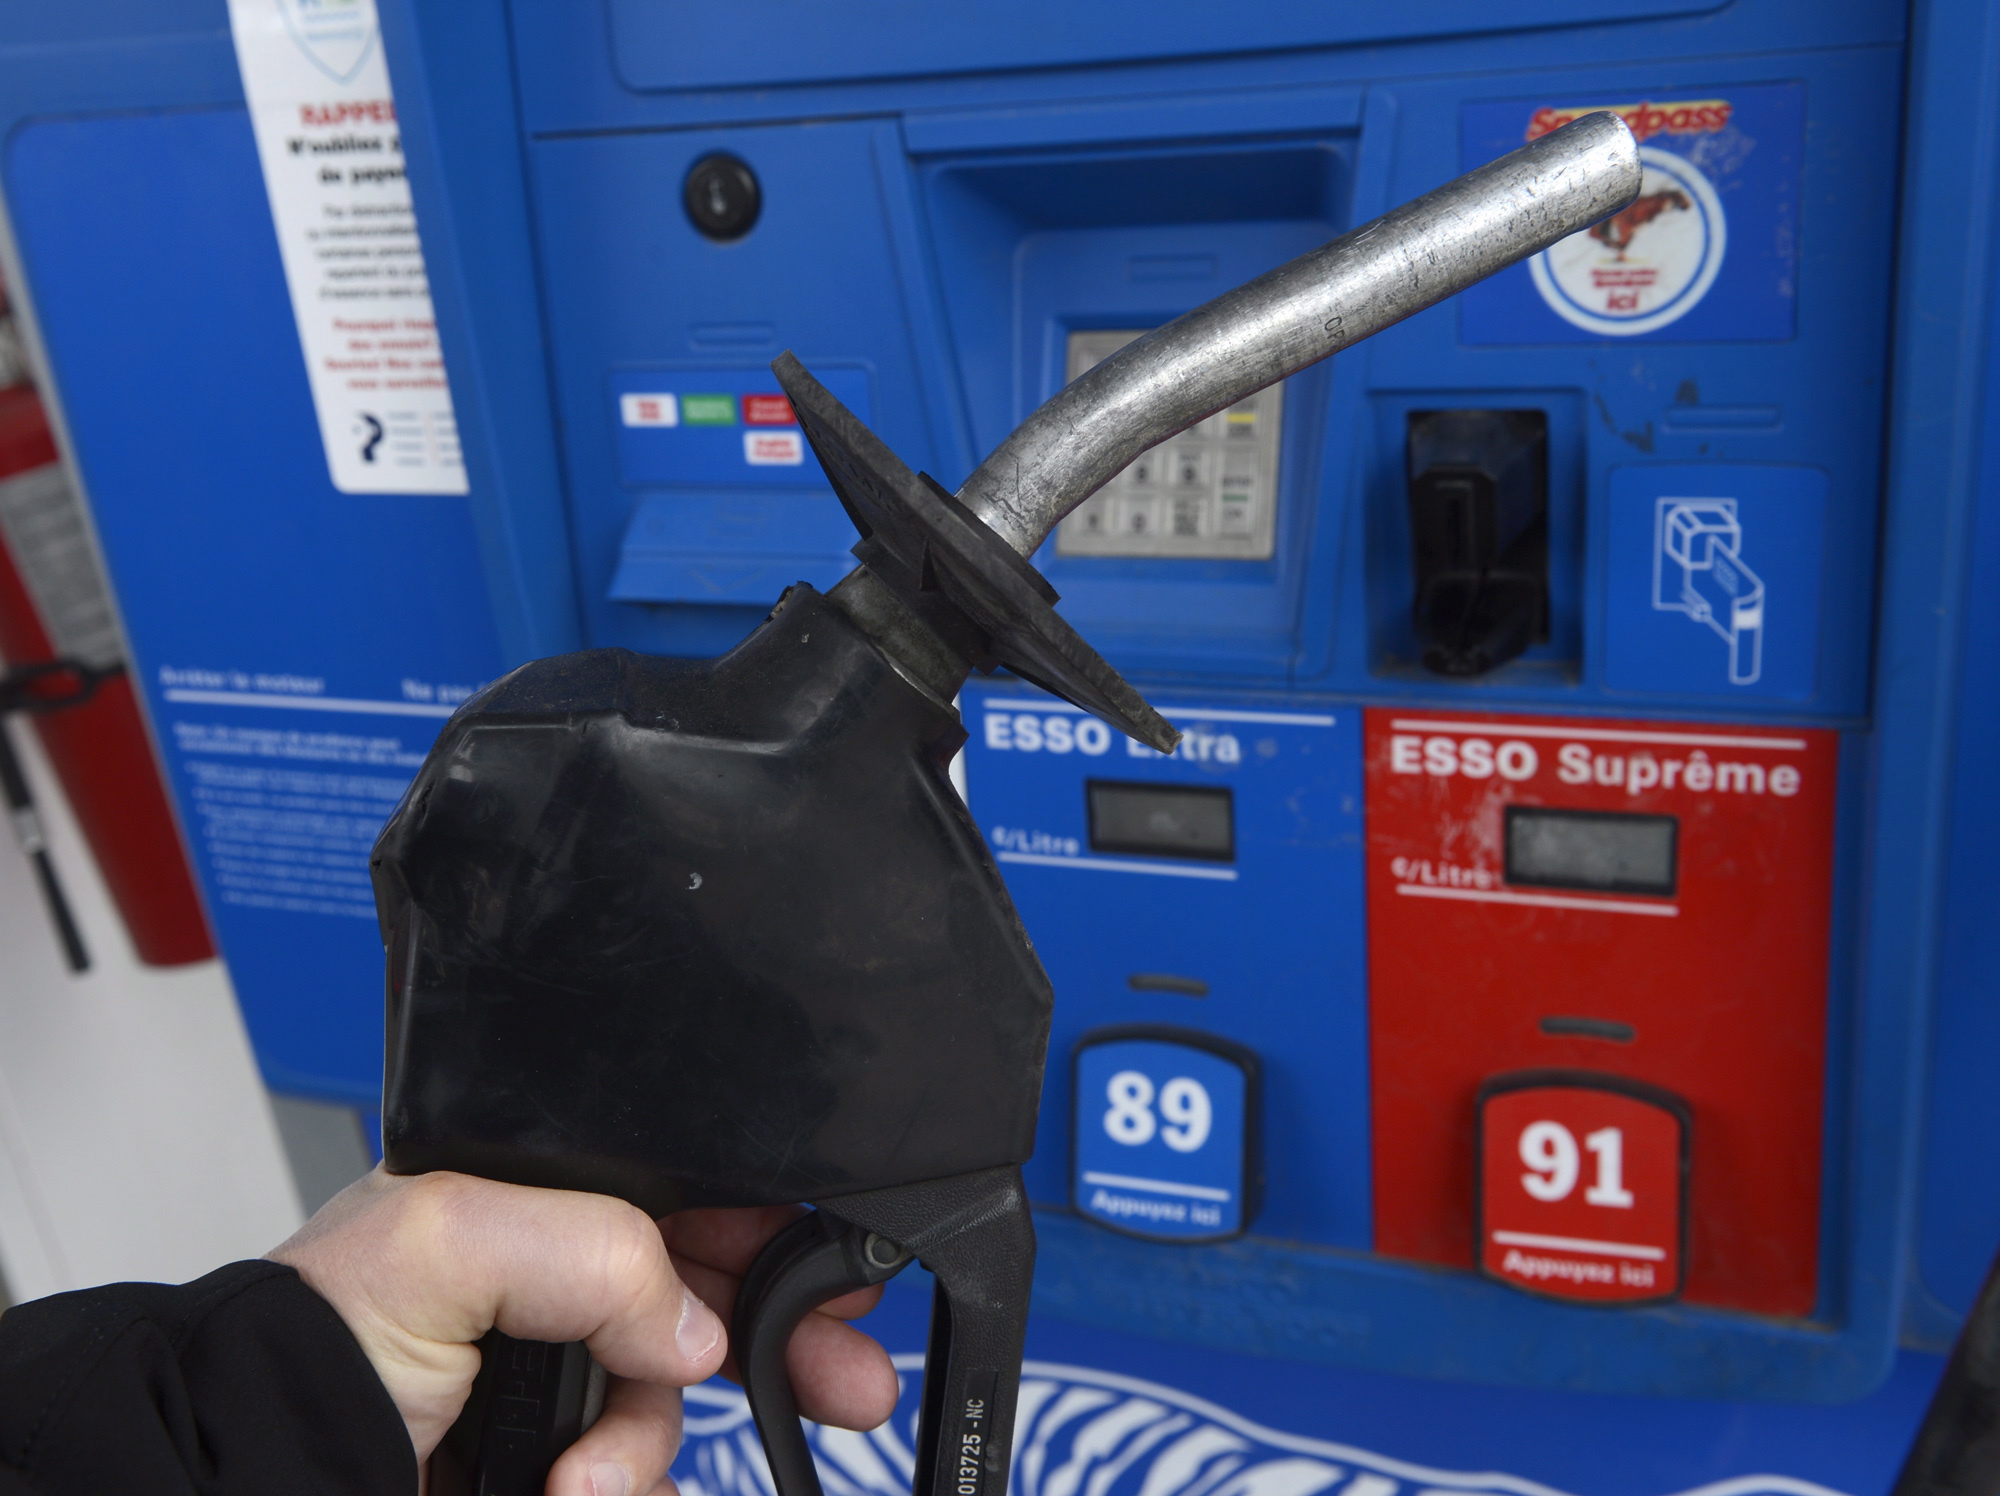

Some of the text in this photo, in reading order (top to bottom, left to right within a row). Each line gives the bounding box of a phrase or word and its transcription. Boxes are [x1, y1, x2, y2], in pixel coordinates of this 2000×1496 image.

[984, 714, 1240, 763] ESSO Etra
[1391, 735, 1800, 796] ESSO Suprême
[1103, 1069, 1213, 1153] 89
[1518, 1120, 1634, 1209] 91
[1091, 1189, 1221, 1226] Appuyez ici
[1503, 1250, 1655, 1287] Appuyez ici
